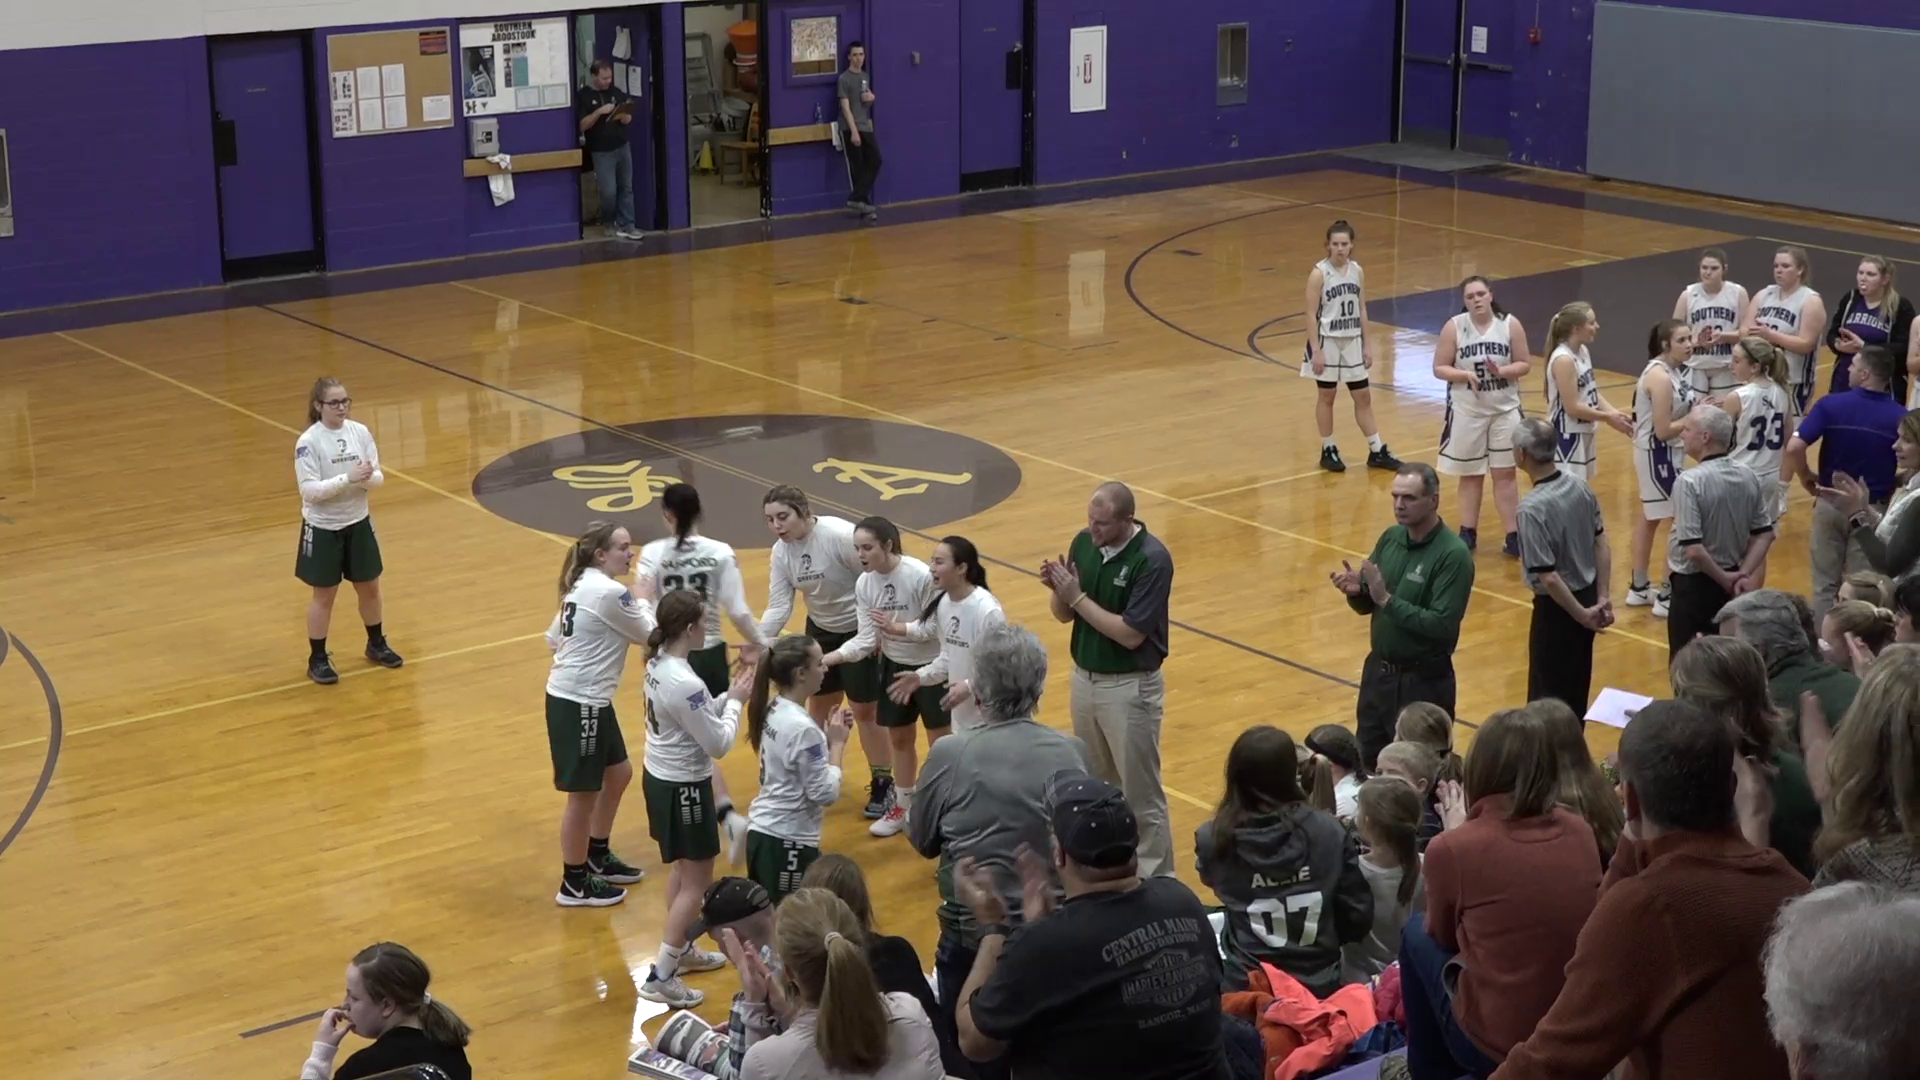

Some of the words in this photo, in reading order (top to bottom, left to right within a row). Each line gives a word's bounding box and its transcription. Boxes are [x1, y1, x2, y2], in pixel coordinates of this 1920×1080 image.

[490, 29, 537, 42] AROOSTOOK
[493, 21, 533, 33] SOUTHERN
[1340, 300, 1354, 317] 10
[1691, 306, 1736, 324] SOUTHERN
[1846, 312, 1891, 333] ARRIORS
[1459, 341, 1509, 360] SOUTHERN
[1746, 412, 1784, 451] 33
[1658, 464, 1668, 478] W
[581, 718, 598, 738] 33
[679, 786, 700, 806] 24
[787, 850, 799, 871] 5
[1251, 865, 1311, 889] ALE
[1246, 890, 1323, 948] 07
[1101, 921, 1165, 962] CENTRAL
[1163, 917, 1201, 934] MAINE
[1115, 932, 1199, 967] HARLEY-DAVIDSON
